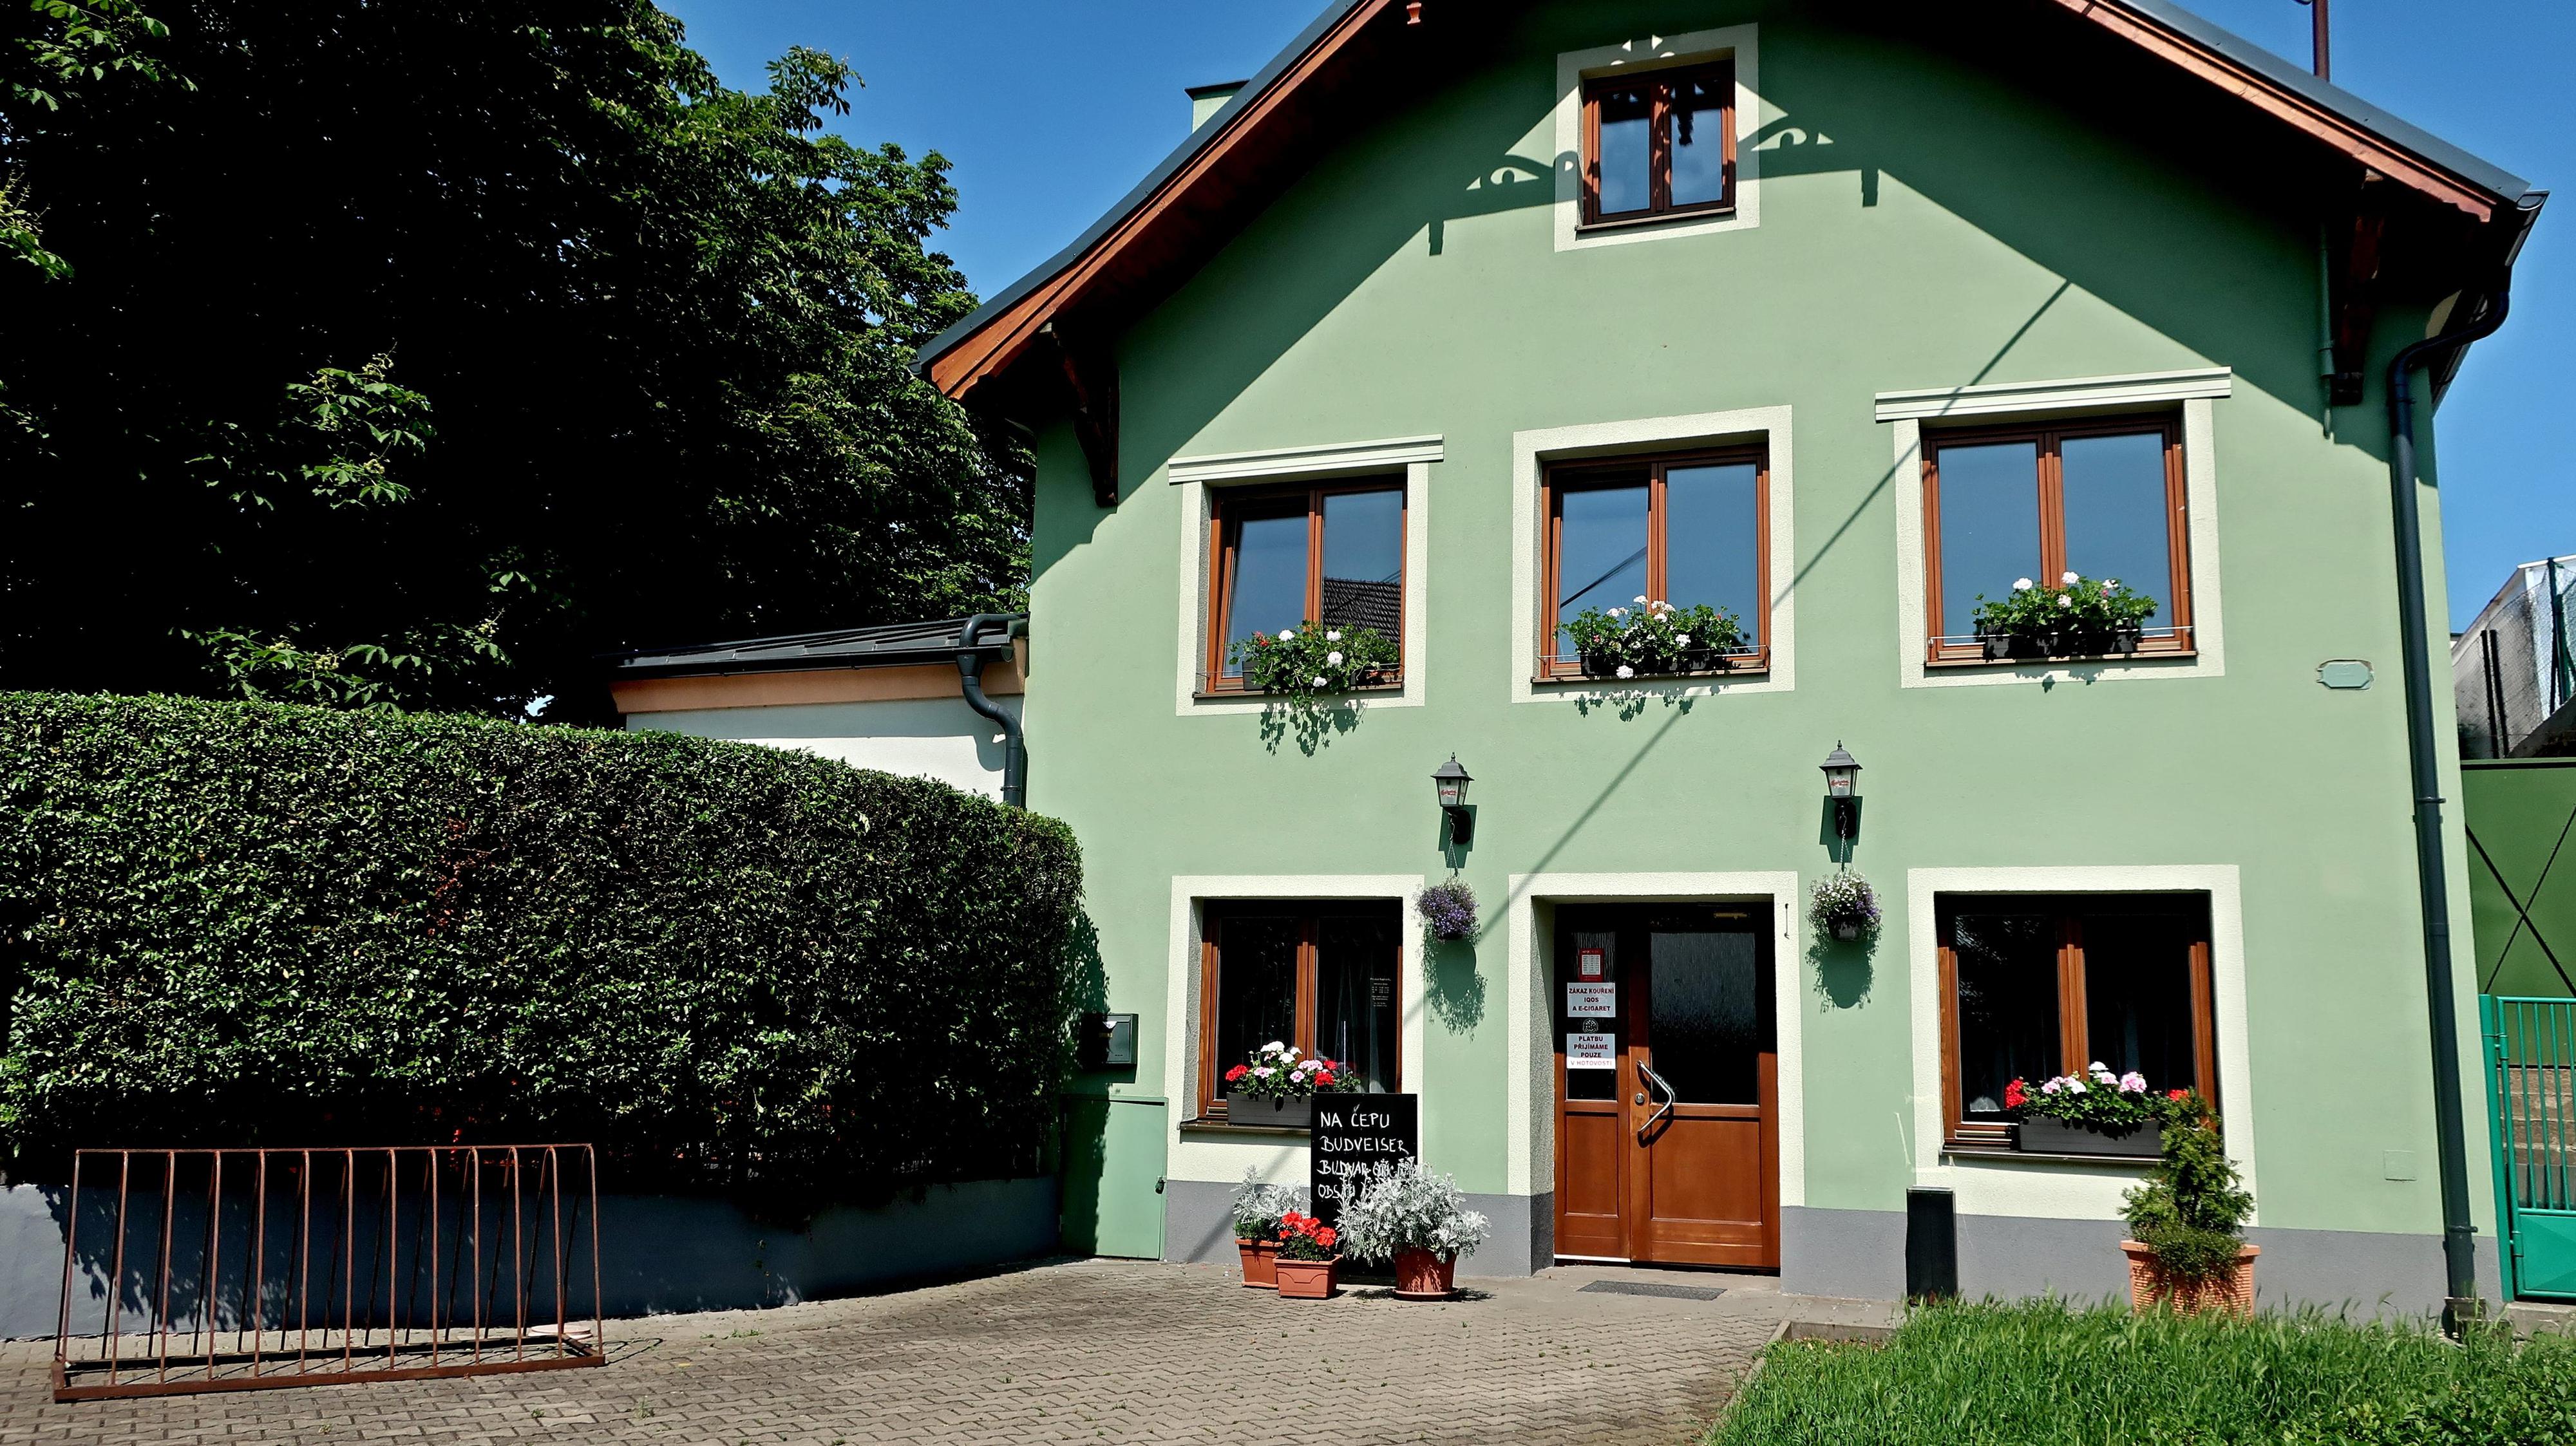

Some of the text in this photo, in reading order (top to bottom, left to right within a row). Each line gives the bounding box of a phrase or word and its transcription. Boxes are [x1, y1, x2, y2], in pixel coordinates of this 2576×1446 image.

[1320, 1103, 1390, 1128] NA ČEPU
[1320, 1136, 1409, 1155] BUDVEISER
